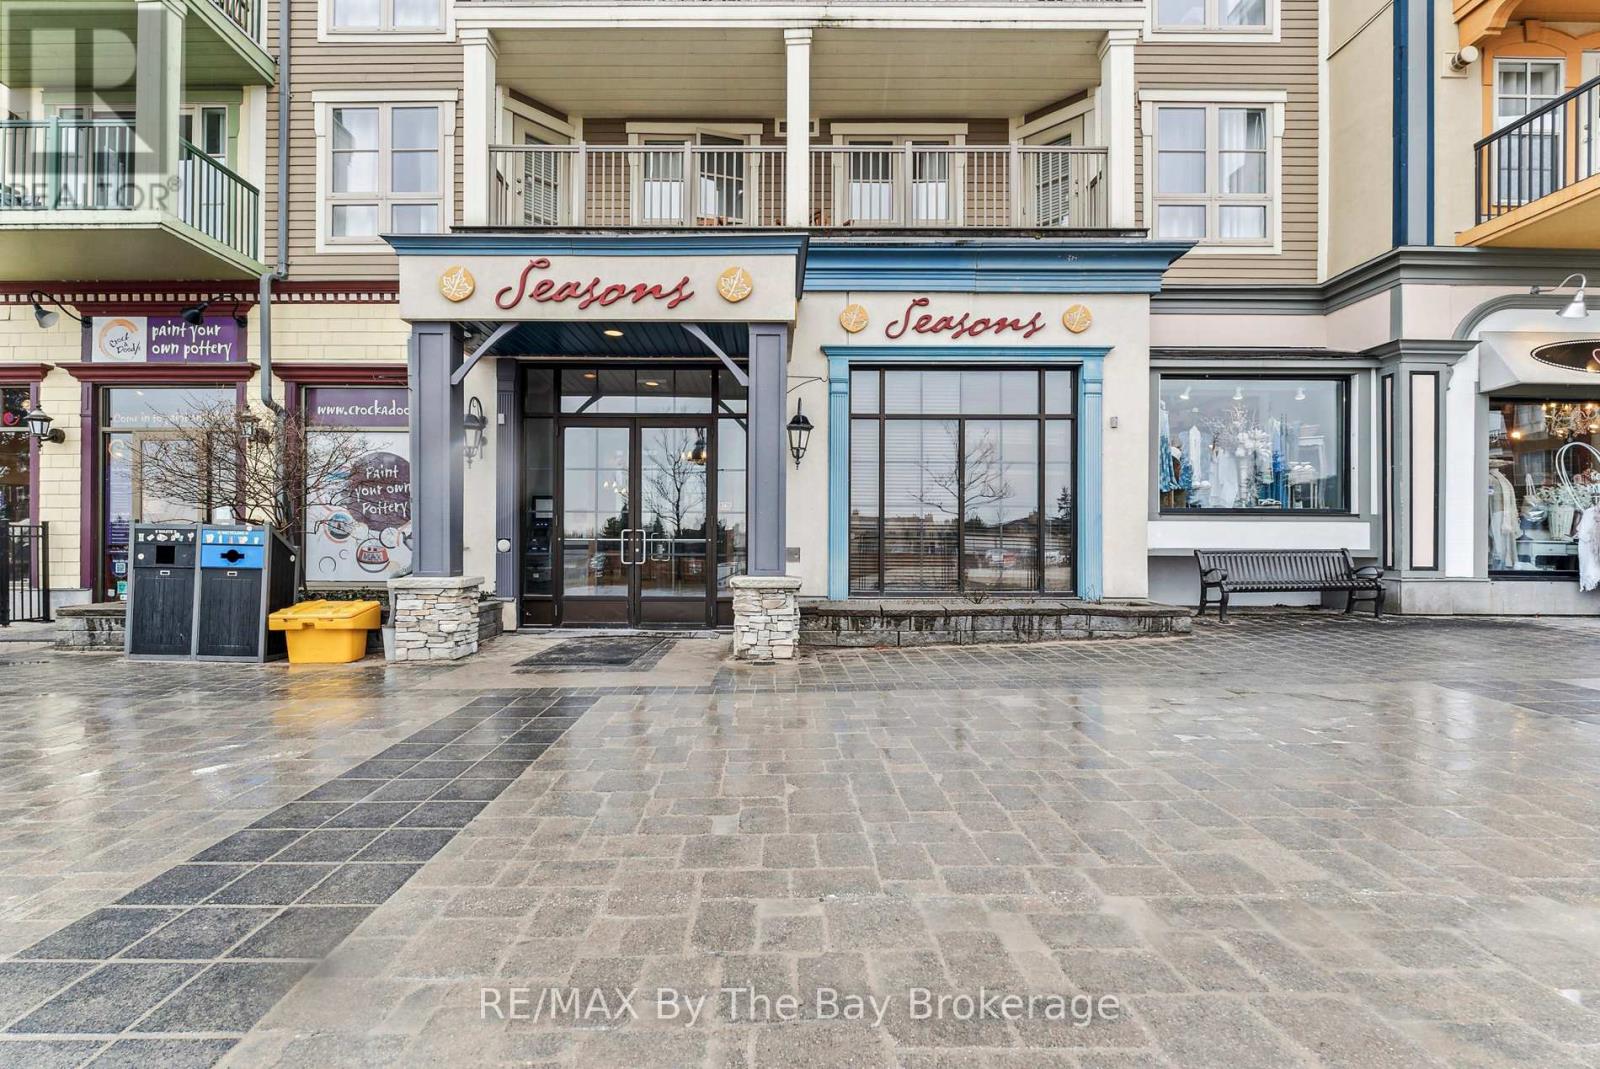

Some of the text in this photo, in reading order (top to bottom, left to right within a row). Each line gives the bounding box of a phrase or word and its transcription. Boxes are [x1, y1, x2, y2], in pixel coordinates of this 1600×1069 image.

[495, 257, 695, 310] Seasons
[885, 297, 1046, 339] Seasons
[152, 320, 222, 343] paint your
[152, 340, 232, 361] own pottery
[366, 464, 399, 479] Paint
[355, 482, 410, 503] your own
[362, 501, 408, 518] Pottery
